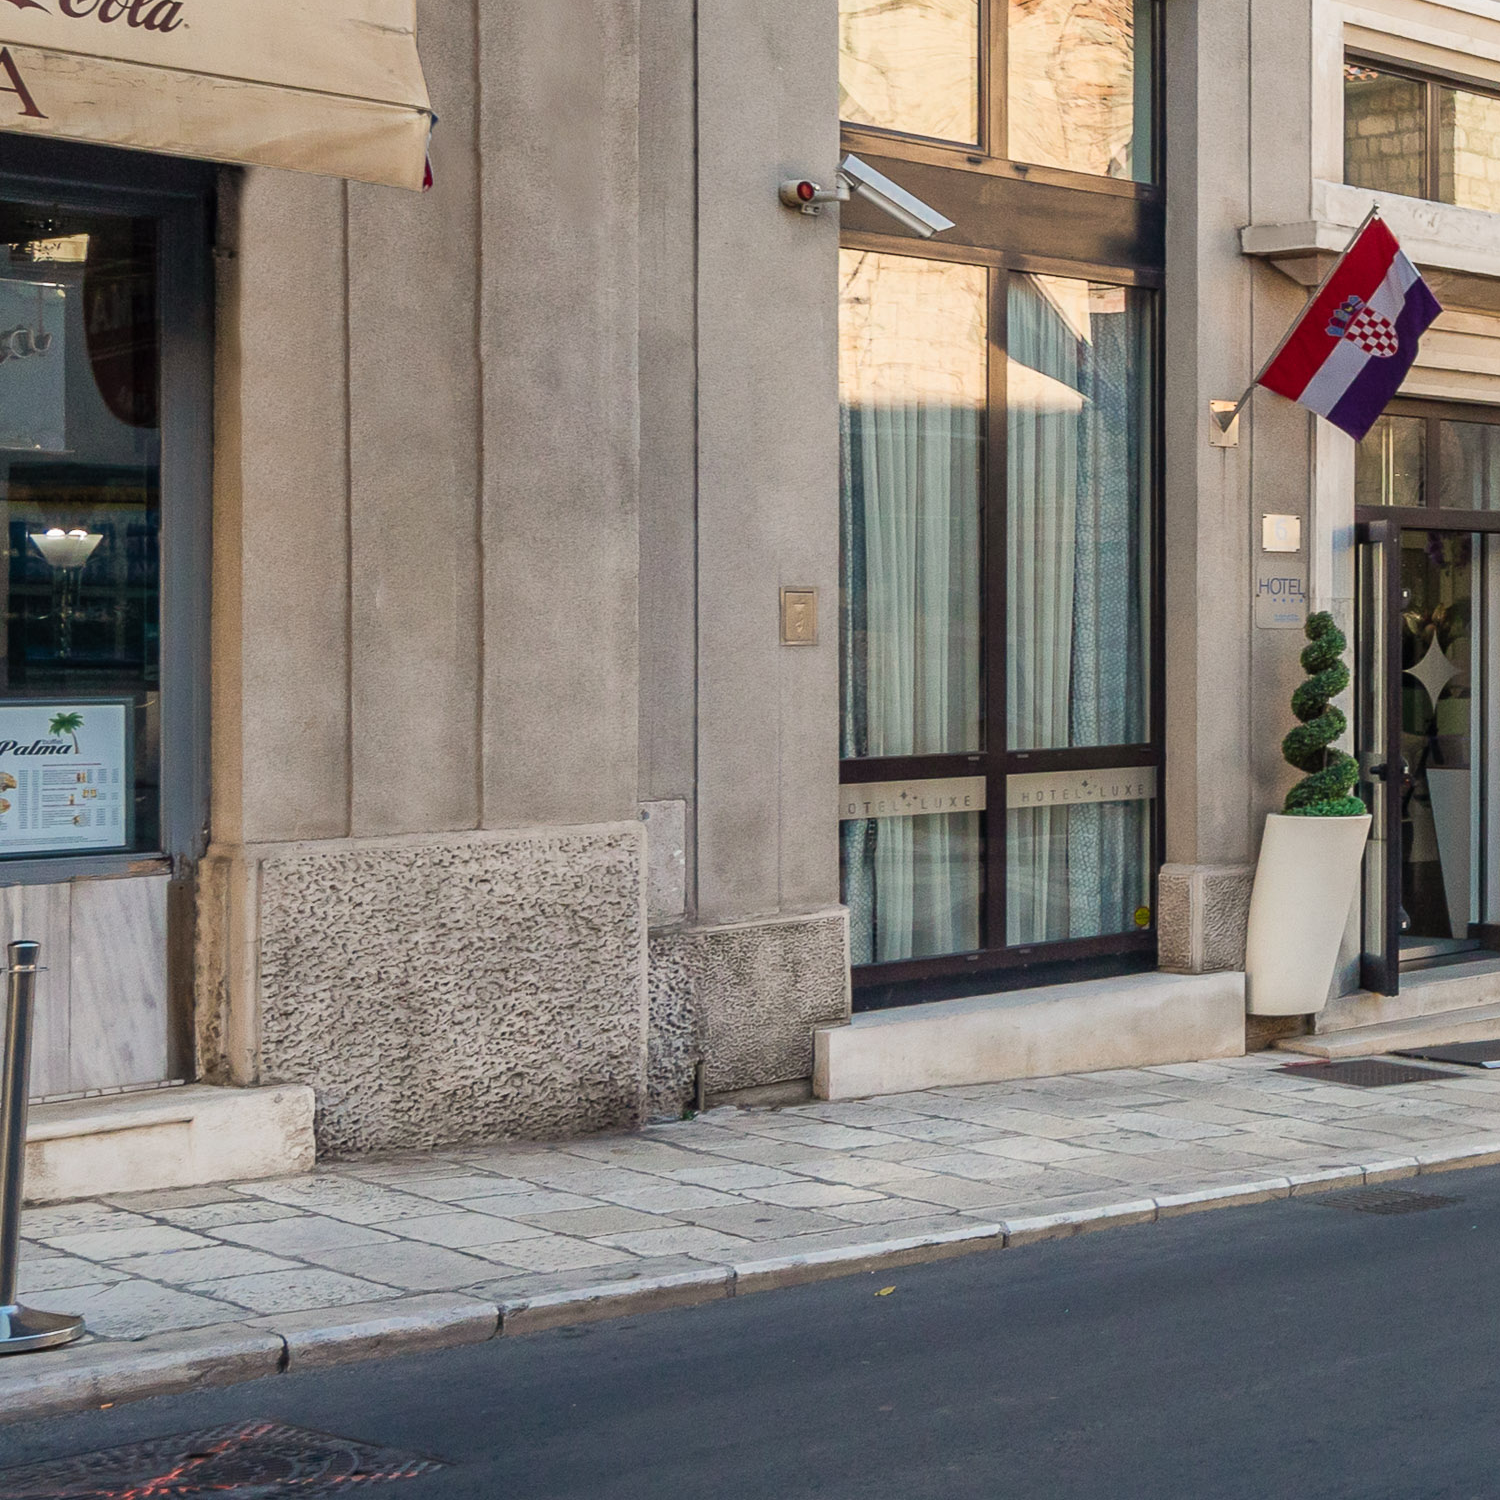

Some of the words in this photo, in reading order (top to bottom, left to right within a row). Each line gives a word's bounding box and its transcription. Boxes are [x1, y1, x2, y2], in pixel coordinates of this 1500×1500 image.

[1274, 518, 1288, 541] 6
[1258, 577, 1305, 596] HOTEL
[0, 739, 73, 756] Palma
[1021, 788, 1083, 803] HOTEL
[1100, 783, 1145, 798] LUXE
[838, 799, 899, 815] OTEL
[920, 794, 972, 811] LUXE
